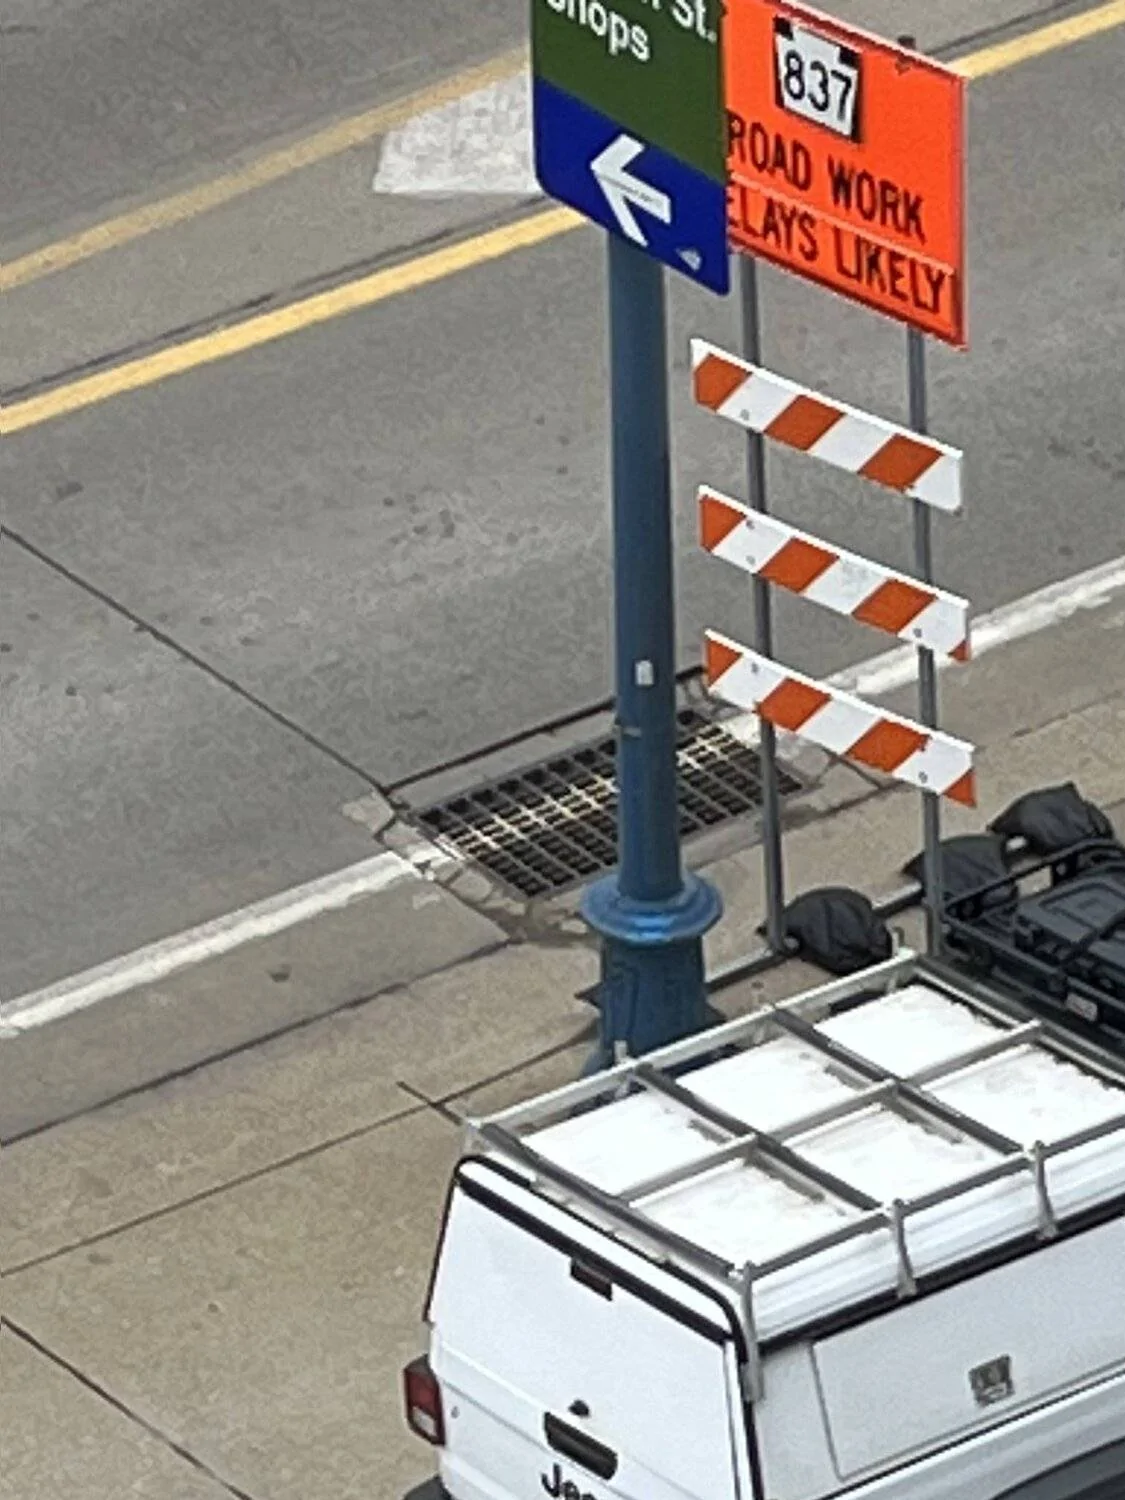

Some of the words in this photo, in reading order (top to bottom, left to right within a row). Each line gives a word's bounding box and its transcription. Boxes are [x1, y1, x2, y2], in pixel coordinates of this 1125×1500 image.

[547, 0, 650, 61] ops
[784, 49, 852, 121] 837
[728, 111, 812, 192] ROAD
[827, 153, 928, 245] WORK
[834, 224, 946, 314] LIKELY
